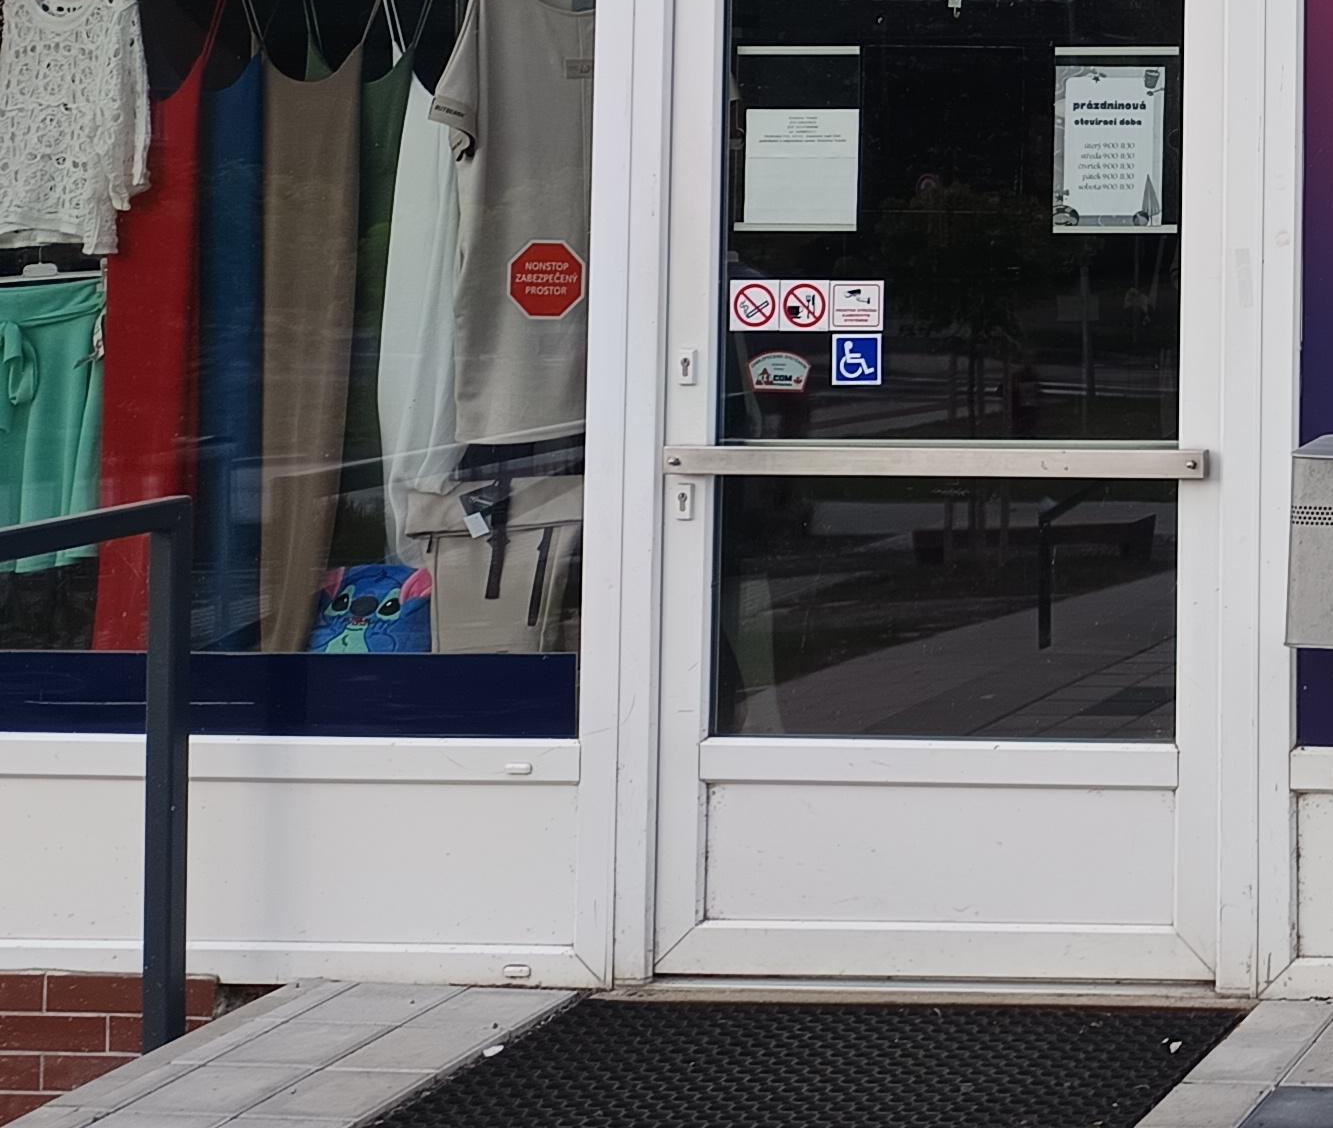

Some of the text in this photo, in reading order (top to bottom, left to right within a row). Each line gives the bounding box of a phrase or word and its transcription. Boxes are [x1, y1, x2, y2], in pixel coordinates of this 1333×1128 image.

[1072, 99, 1146, 111] prázdninová
[1119, 117, 1142, 126] doba
[524, 261, 569, 271] NONSTOP
[515, 272, 578, 284] ZABEZPEČENÝ
[525, 286, 567, 295] PROSTOR
